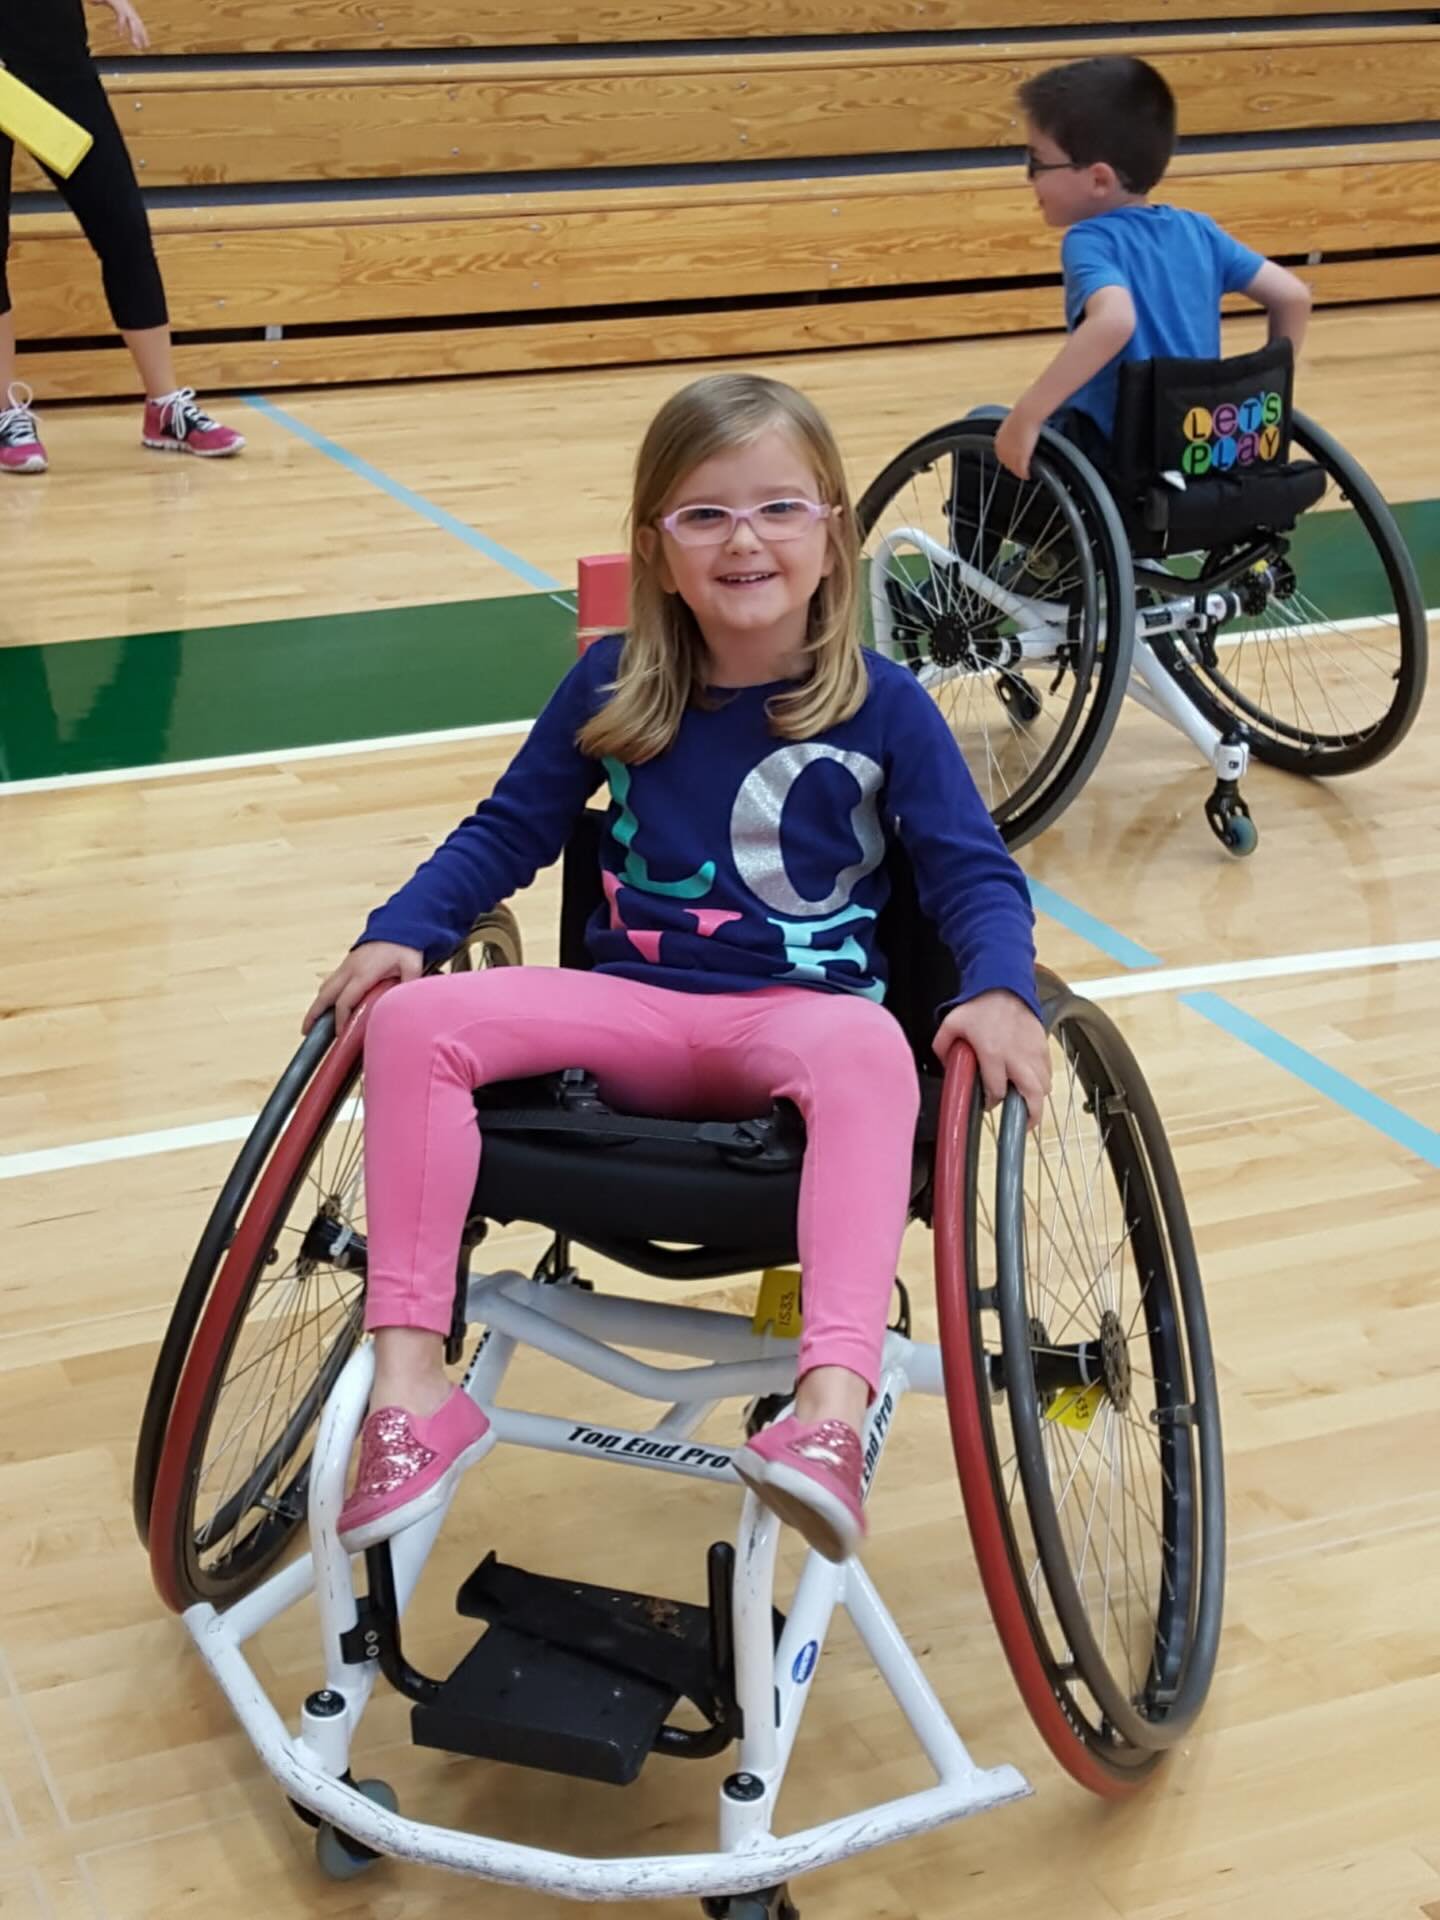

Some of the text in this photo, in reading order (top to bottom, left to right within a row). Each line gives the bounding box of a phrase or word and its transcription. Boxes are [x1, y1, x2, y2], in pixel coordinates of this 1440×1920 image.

[568, 1426, 731, 1469] Top End Pro
